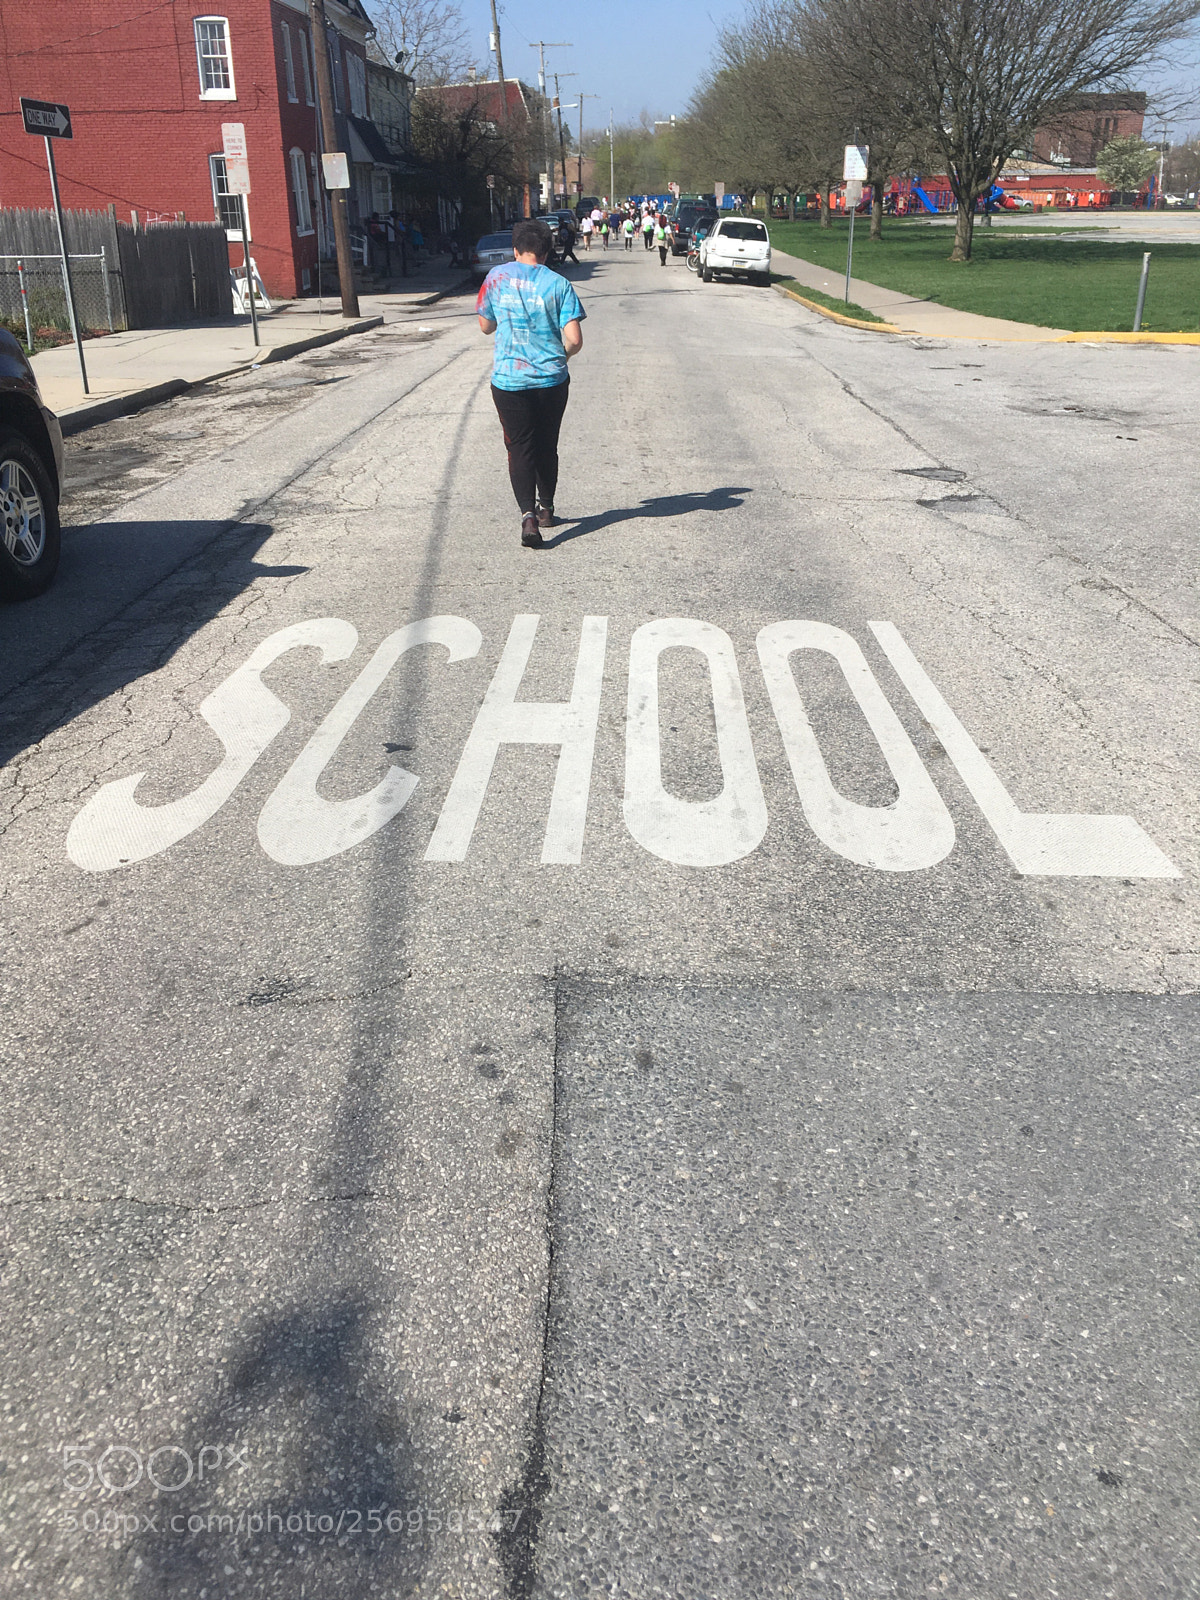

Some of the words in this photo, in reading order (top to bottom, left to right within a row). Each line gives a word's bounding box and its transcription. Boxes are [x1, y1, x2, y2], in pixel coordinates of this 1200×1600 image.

[28, 110, 41, 124] ONE
[42, 112, 56, 126] WAY
[65, 614, 1184, 878] SCHOOL
